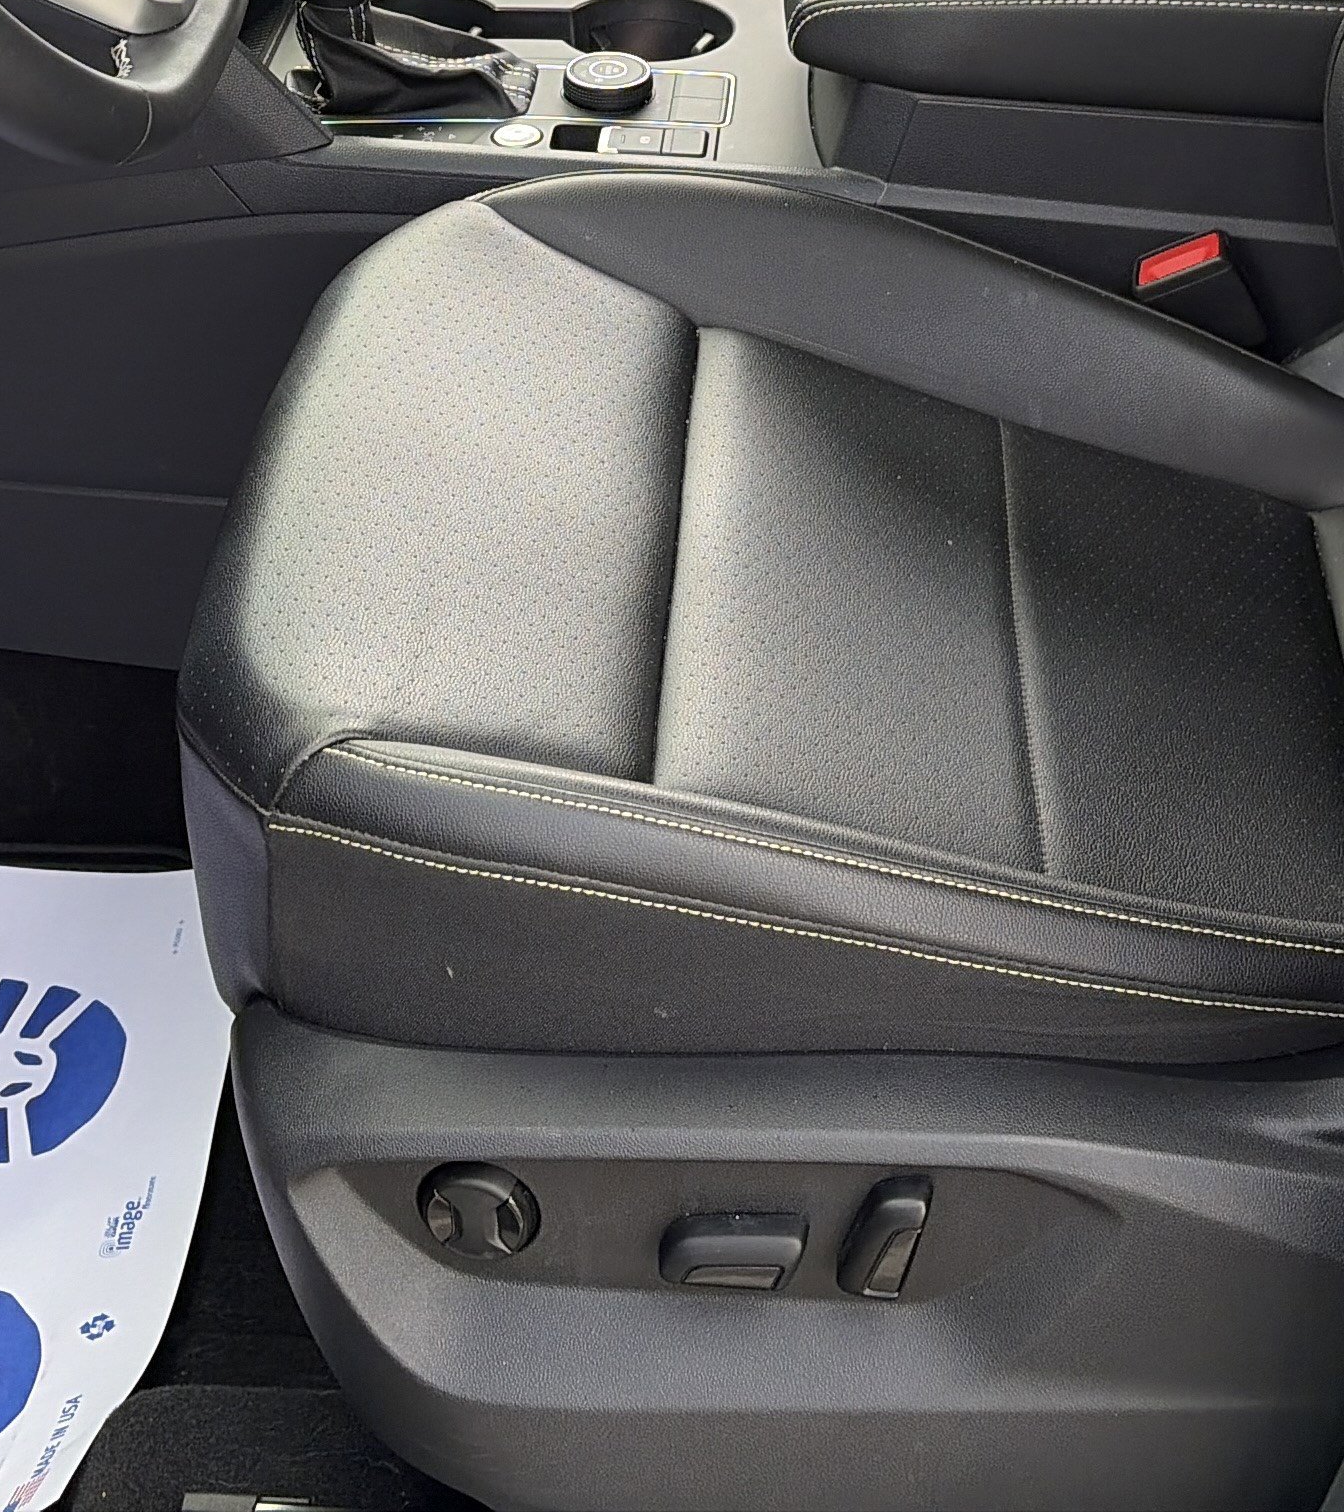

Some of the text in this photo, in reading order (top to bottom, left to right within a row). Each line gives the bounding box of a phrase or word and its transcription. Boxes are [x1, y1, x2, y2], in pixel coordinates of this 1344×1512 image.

[116, 1199, 143, 1250] image
[31, 1394, 82, 1478] MADE IN USA
